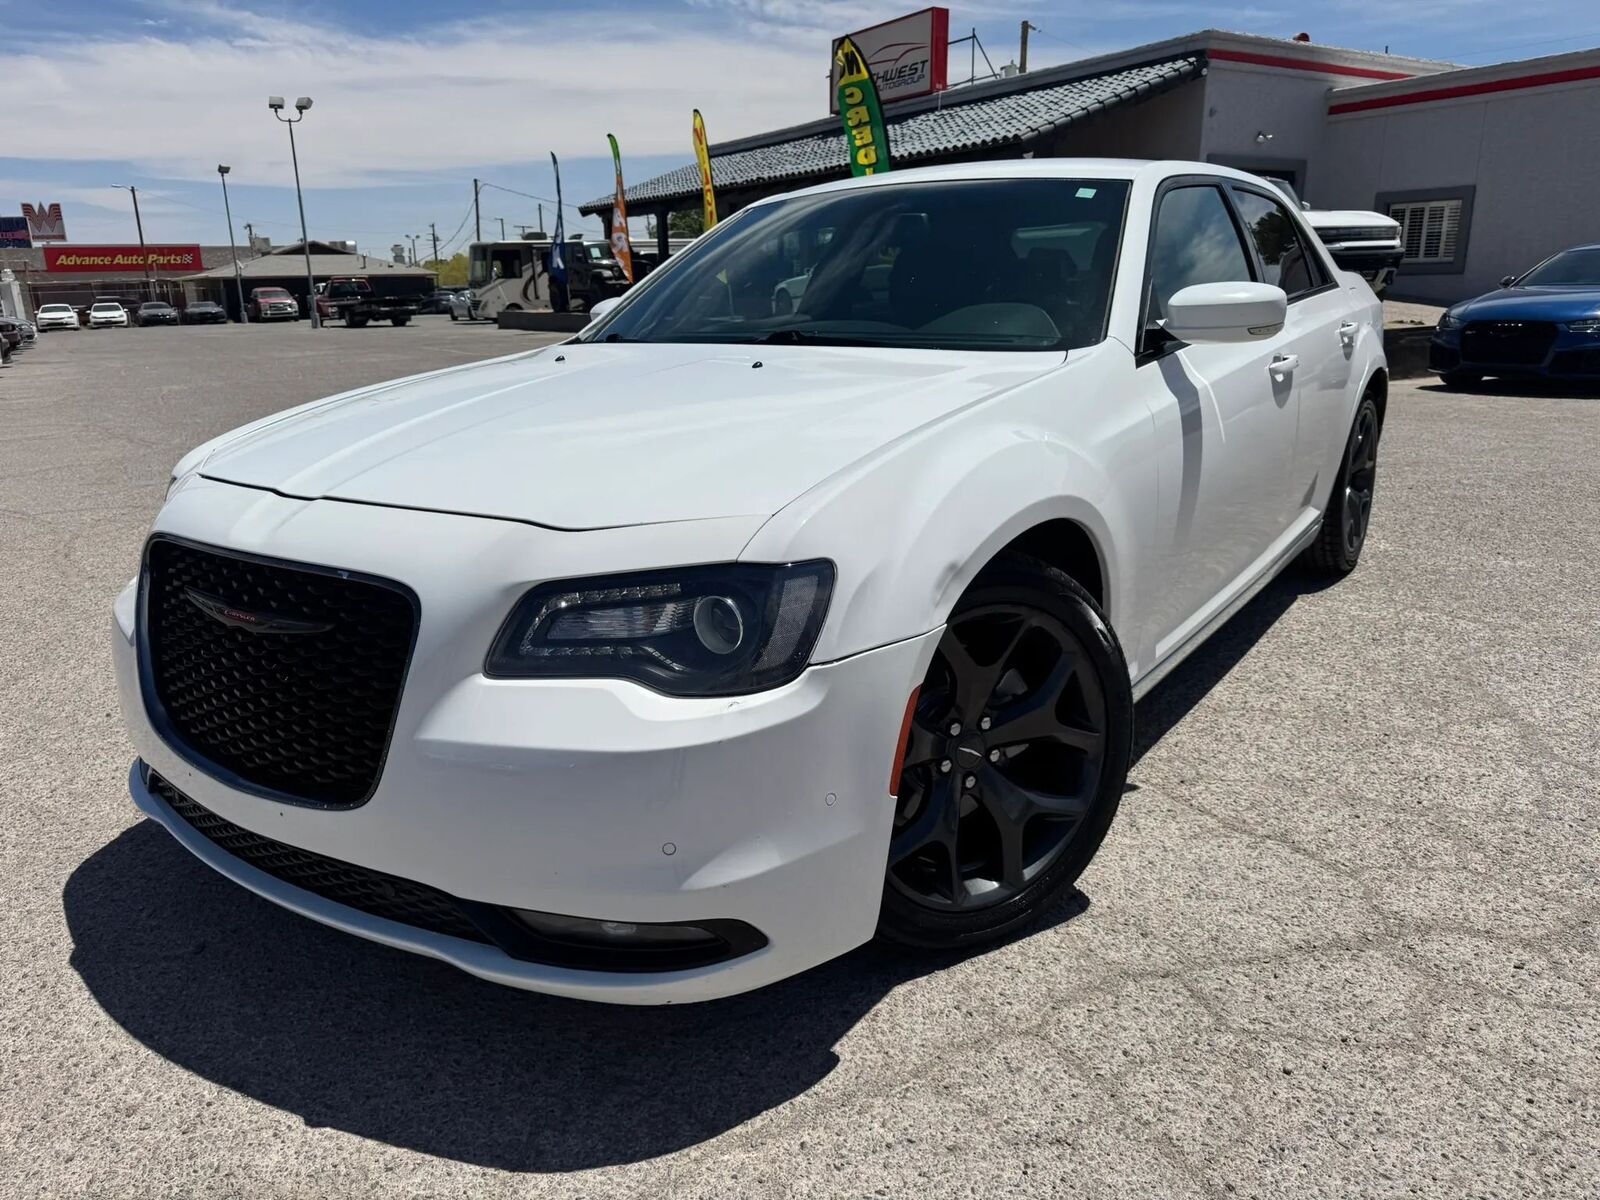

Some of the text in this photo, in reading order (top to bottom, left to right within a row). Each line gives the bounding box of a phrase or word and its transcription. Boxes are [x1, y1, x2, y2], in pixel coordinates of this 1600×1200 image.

[872, 59, 929, 83] HWEST
[877, 74, 925, 92] UTOGROUP
[56, 254, 182, 266] Advance Auto Parts
